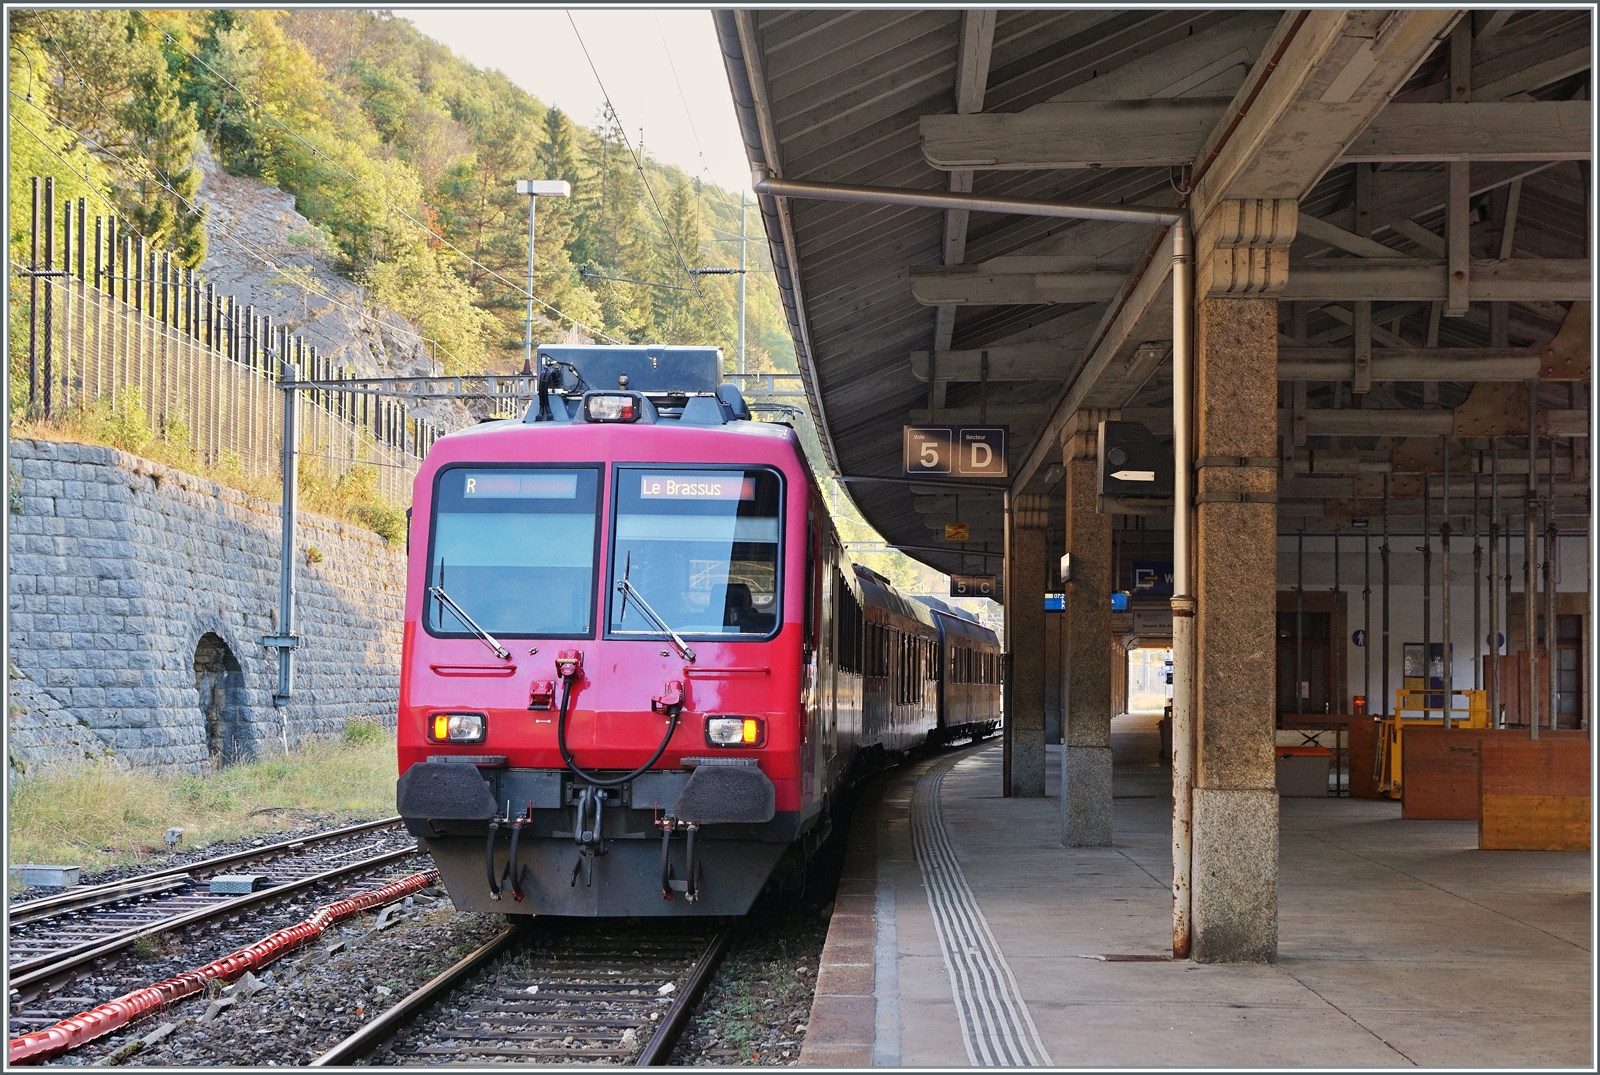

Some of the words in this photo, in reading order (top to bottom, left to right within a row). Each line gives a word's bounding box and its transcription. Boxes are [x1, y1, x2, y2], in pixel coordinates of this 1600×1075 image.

[920, 442, 939, 468] 5
[971, 442, 993, 468] D
[466, 478, 477, 494] R
[643, 479, 661, 495] Le
[666, 479, 722, 496] Brassus
[957, 581, 966, 594] 5
[980, 582, 990, 594] C
